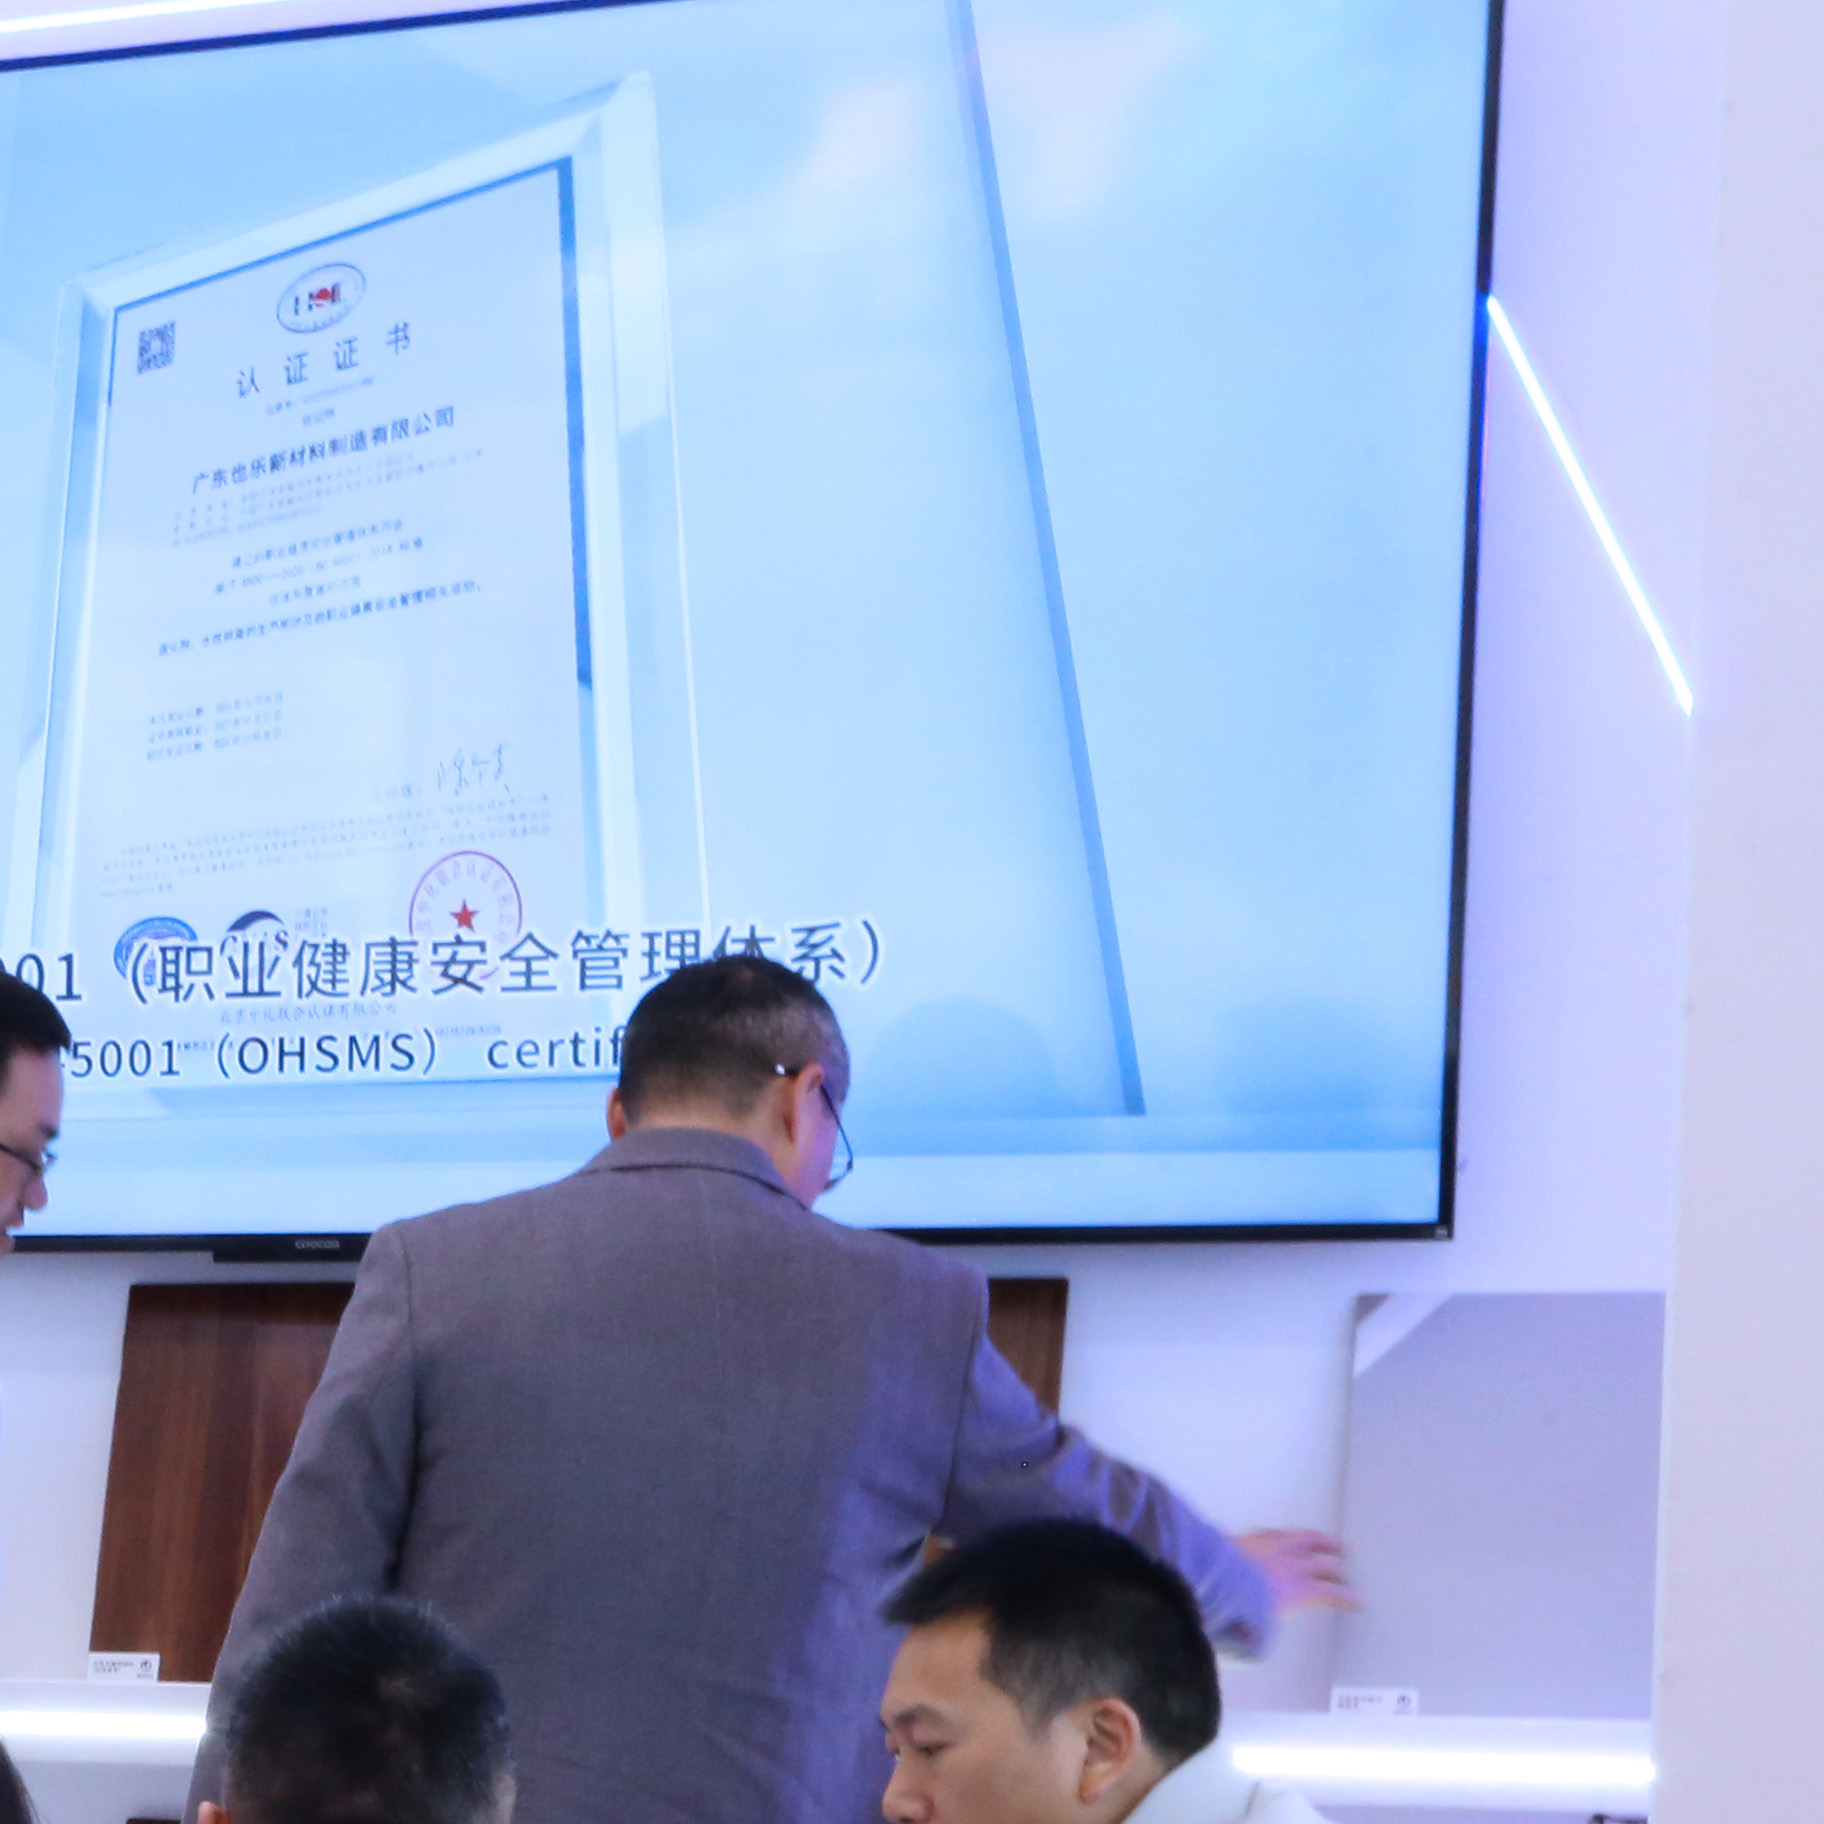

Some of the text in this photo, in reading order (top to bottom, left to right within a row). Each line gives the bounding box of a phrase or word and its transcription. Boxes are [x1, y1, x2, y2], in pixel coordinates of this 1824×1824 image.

[236, 321, 411, 399] 认证证书
[60, 1039, 181, 1079] 5001
